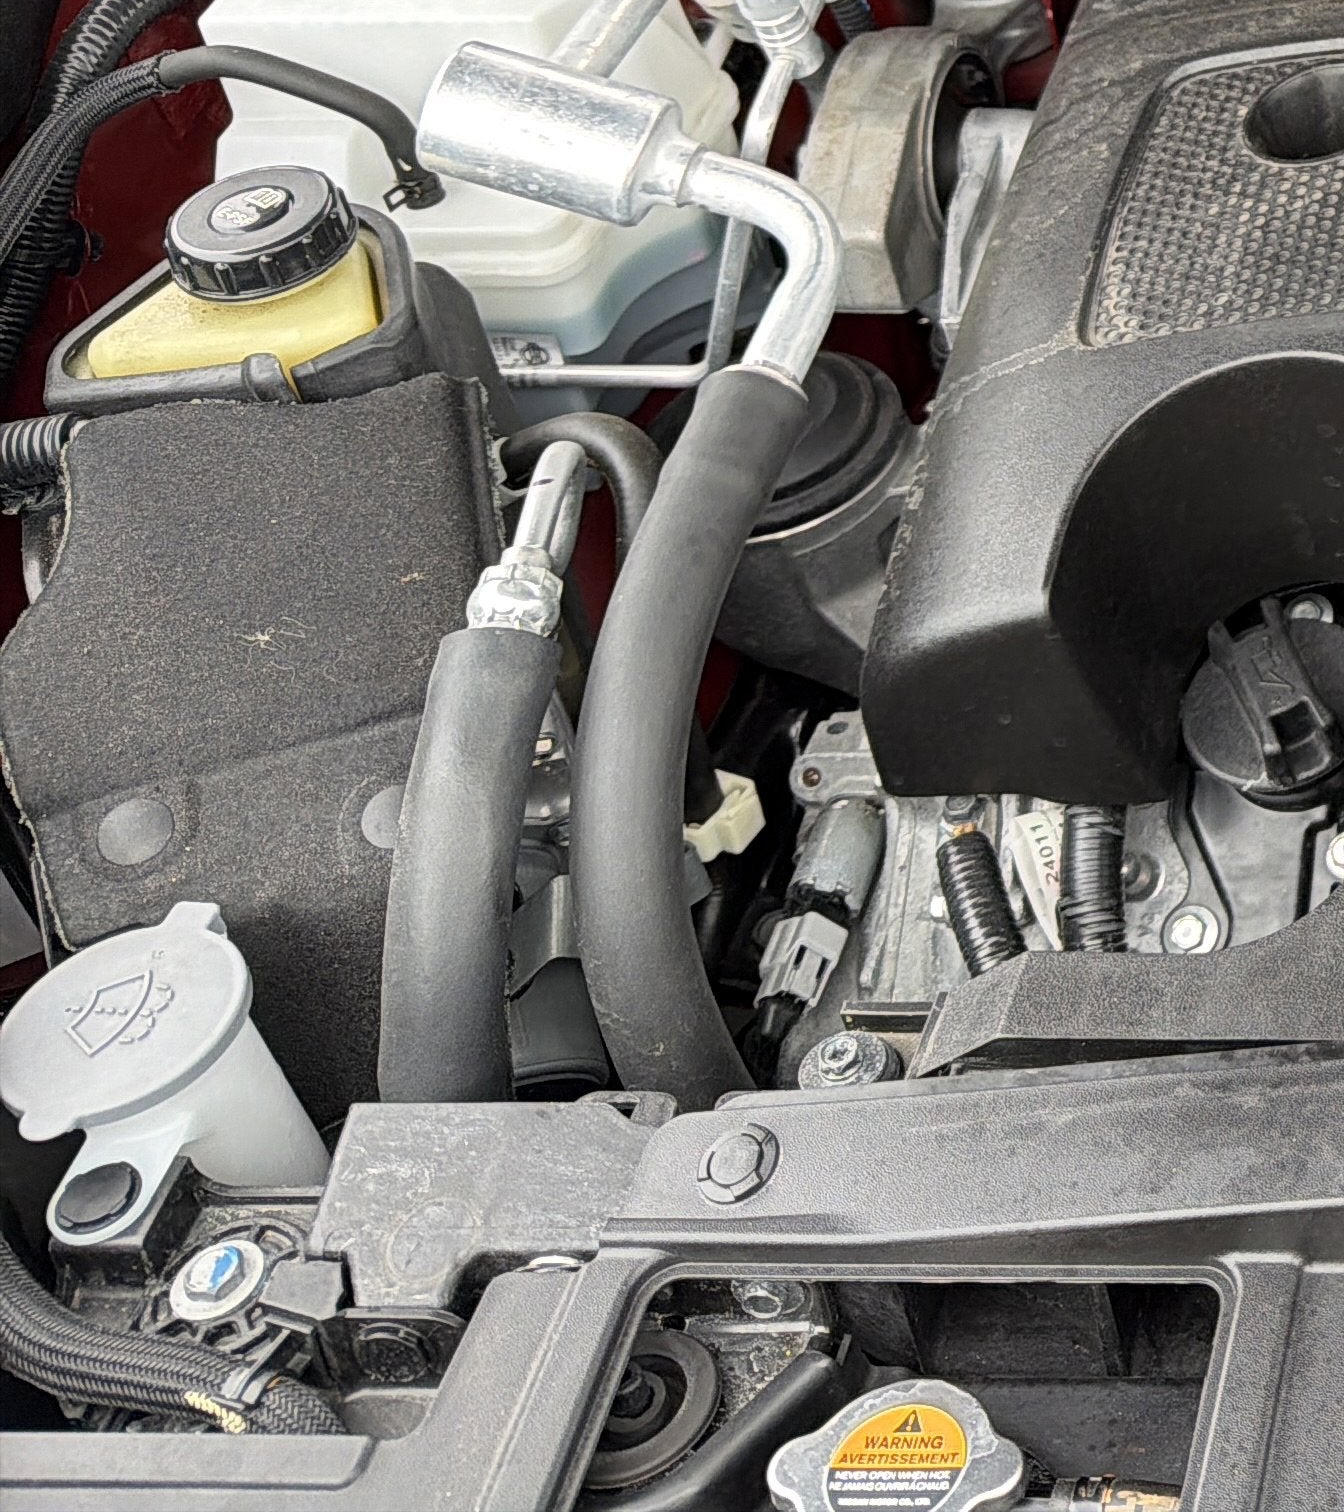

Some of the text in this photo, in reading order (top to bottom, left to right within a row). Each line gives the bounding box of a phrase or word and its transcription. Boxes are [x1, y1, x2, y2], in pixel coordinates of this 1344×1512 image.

[864, 1435, 944, 1449] WARNING
[838, 1452, 960, 1465] AVERTISSEMENT
[835, 1470, 868, 1480] NEVER
[868, 1470, 897, 1480] OPEN
[897, 1470, 928, 1480] WHEN
